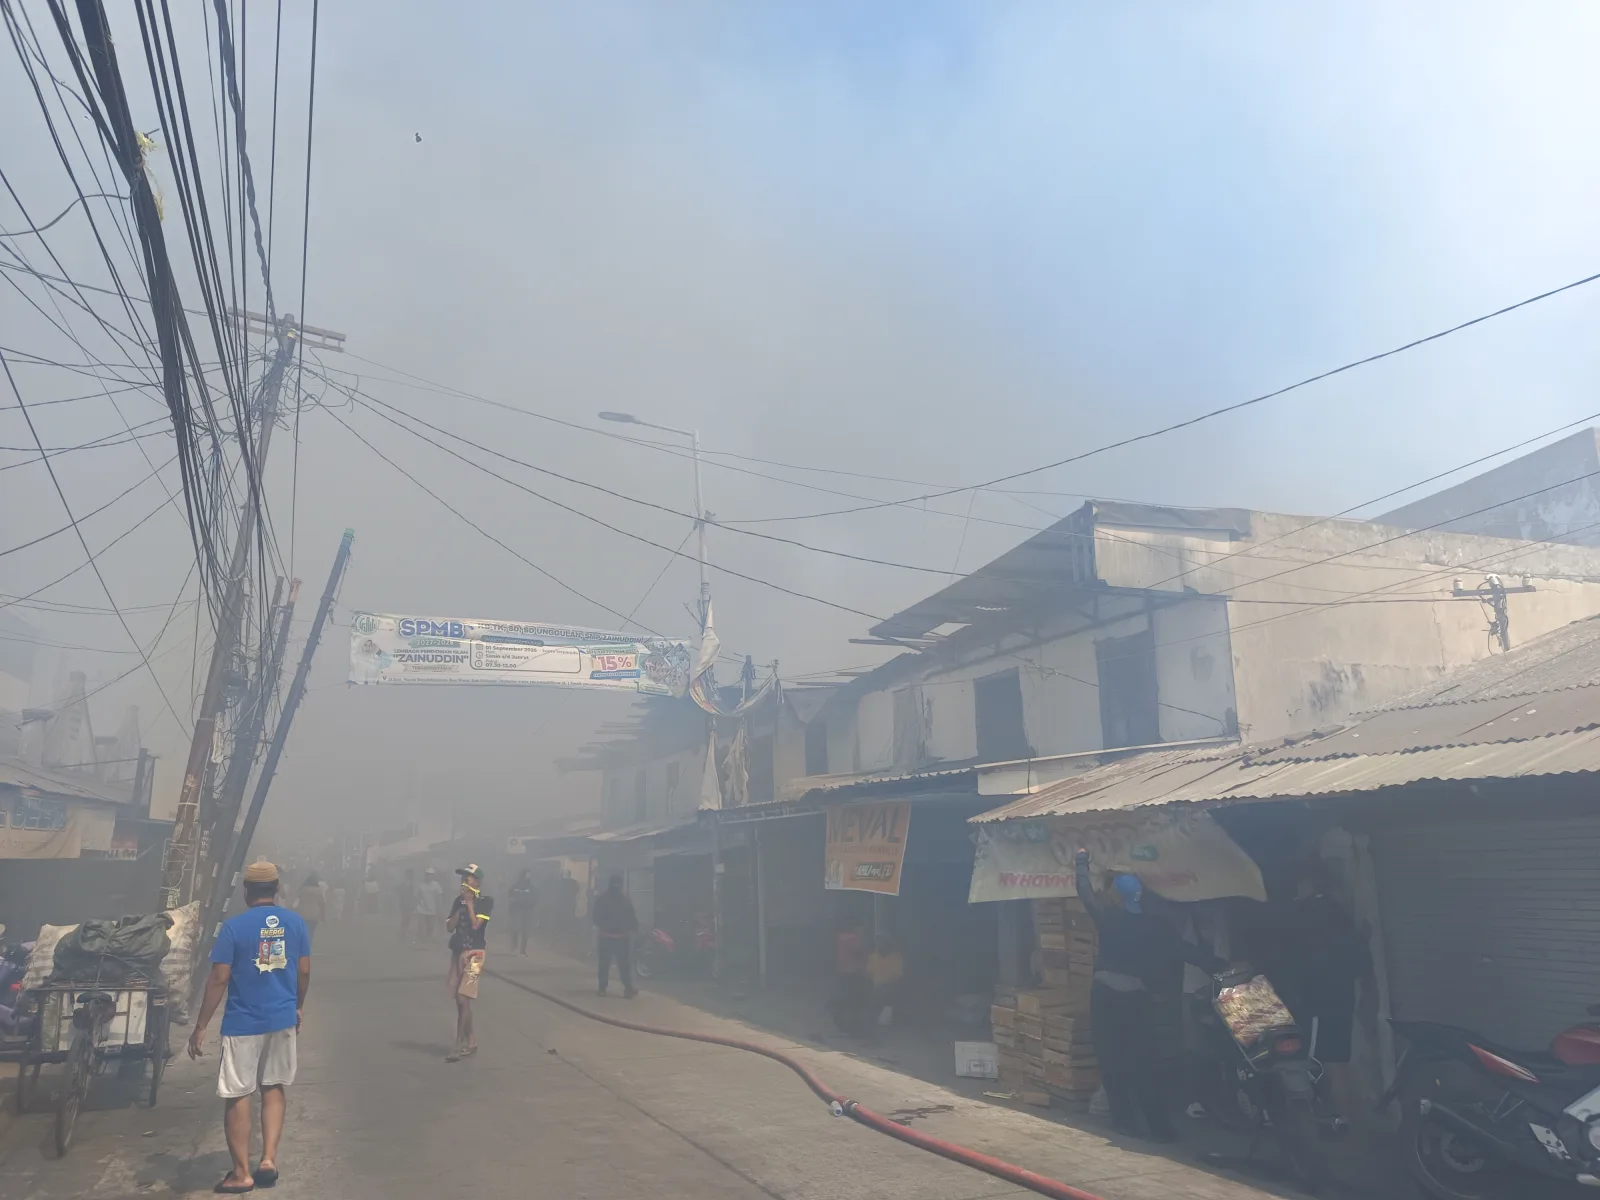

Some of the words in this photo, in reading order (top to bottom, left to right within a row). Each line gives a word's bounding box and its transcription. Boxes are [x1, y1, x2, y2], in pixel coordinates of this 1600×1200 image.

[401, 619, 464, 638] SPMB
[393, 653, 469, 664] "ZAINUDDIN"
[597, 656, 632, 671] 15%
